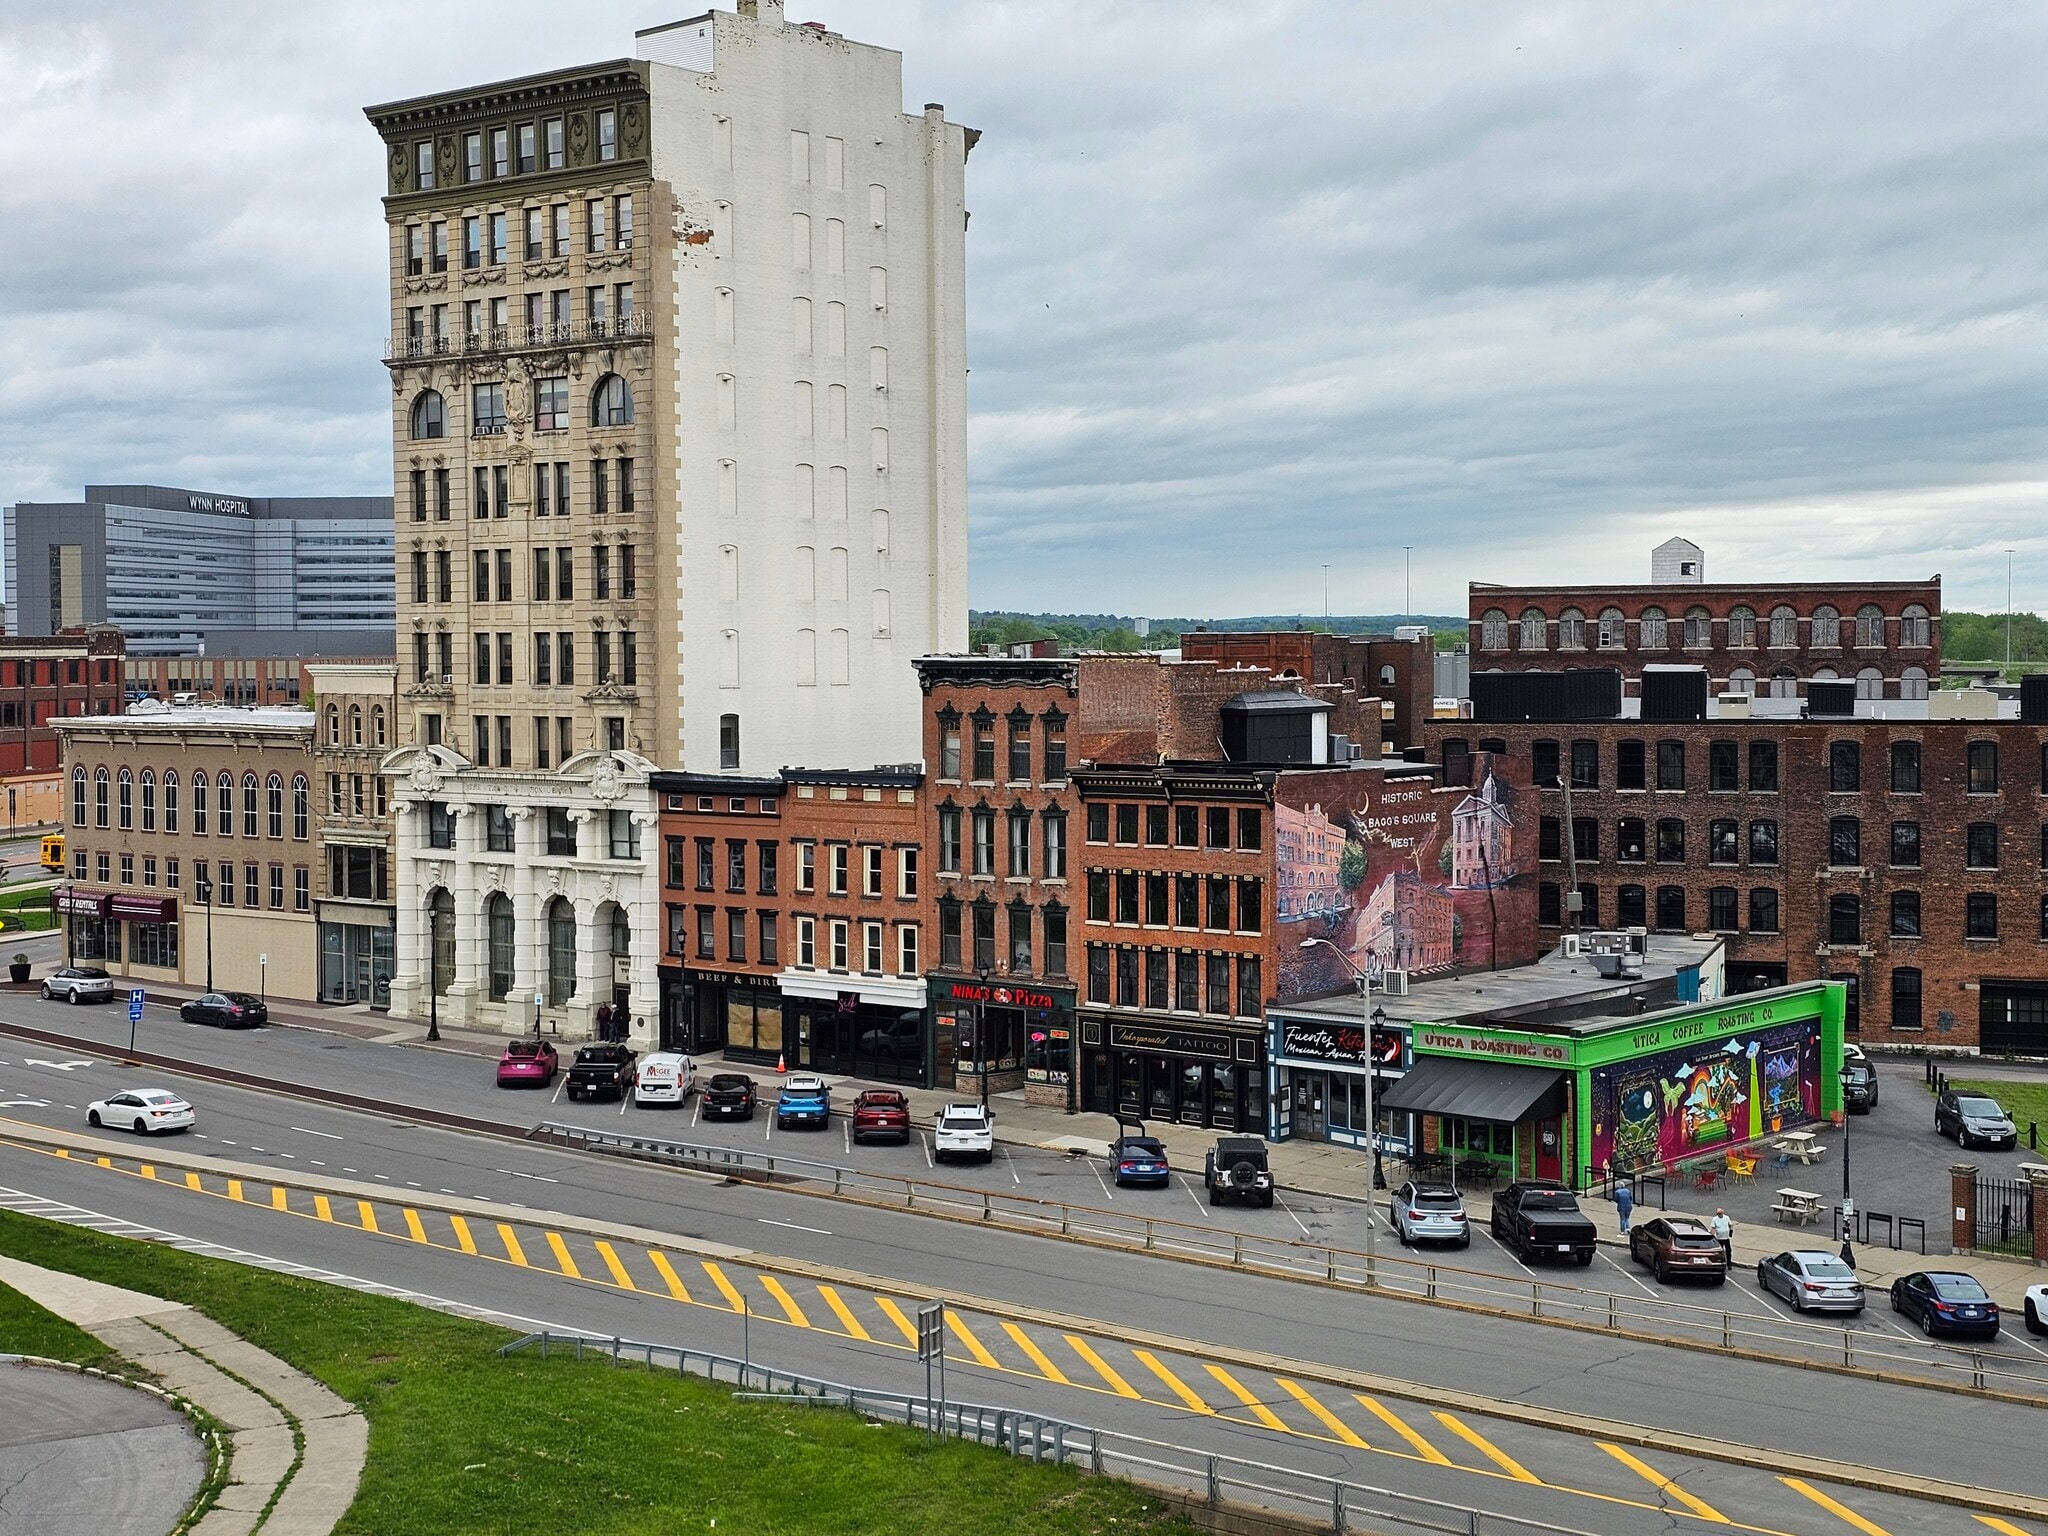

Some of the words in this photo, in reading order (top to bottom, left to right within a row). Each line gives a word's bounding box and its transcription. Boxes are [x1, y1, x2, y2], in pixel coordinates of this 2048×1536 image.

[189, 495, 212, 511] WYNN
[215, 499, 250, 515] HOSPITAL
[1381, 791, 1423, 804] HISTORIC
[1368, 816, 1400, 828] BAGG'S
[1402, 812, 1437, 825] SQUARE
[1390, 837, 1415, 849] WEST
[58, 897, 76, 908] GRET
[75, 899, 98, 910] RENTALS
[697, 972, 728, 982] BEEF
[733, 975, 742, 985] &
[132, 990, 142, 1002] H
[952, 984, 991, 1001] NINAS
[1015, 989, 1053, 1008] Pizza
[1284, 1026, 1335, 1048] Fuentes
[1632, 1032, 1660, 1049] UTICA
[1672, 1022, 1704, 1040] COFFEE
[1717, 1011, 1755, 1031] ROASTING
[1177, 1037, 1227, 1051] TATTOO
[1285, 1043, 1323, 1056] Mexican
[1325, 1048, 1356, 1060] Asian
[1424, 1034, 1464, 1049] UTICA
[1470, 1039, 1537, 1057] ROASTING
[1543, 1046, 1562, 1059] CO
